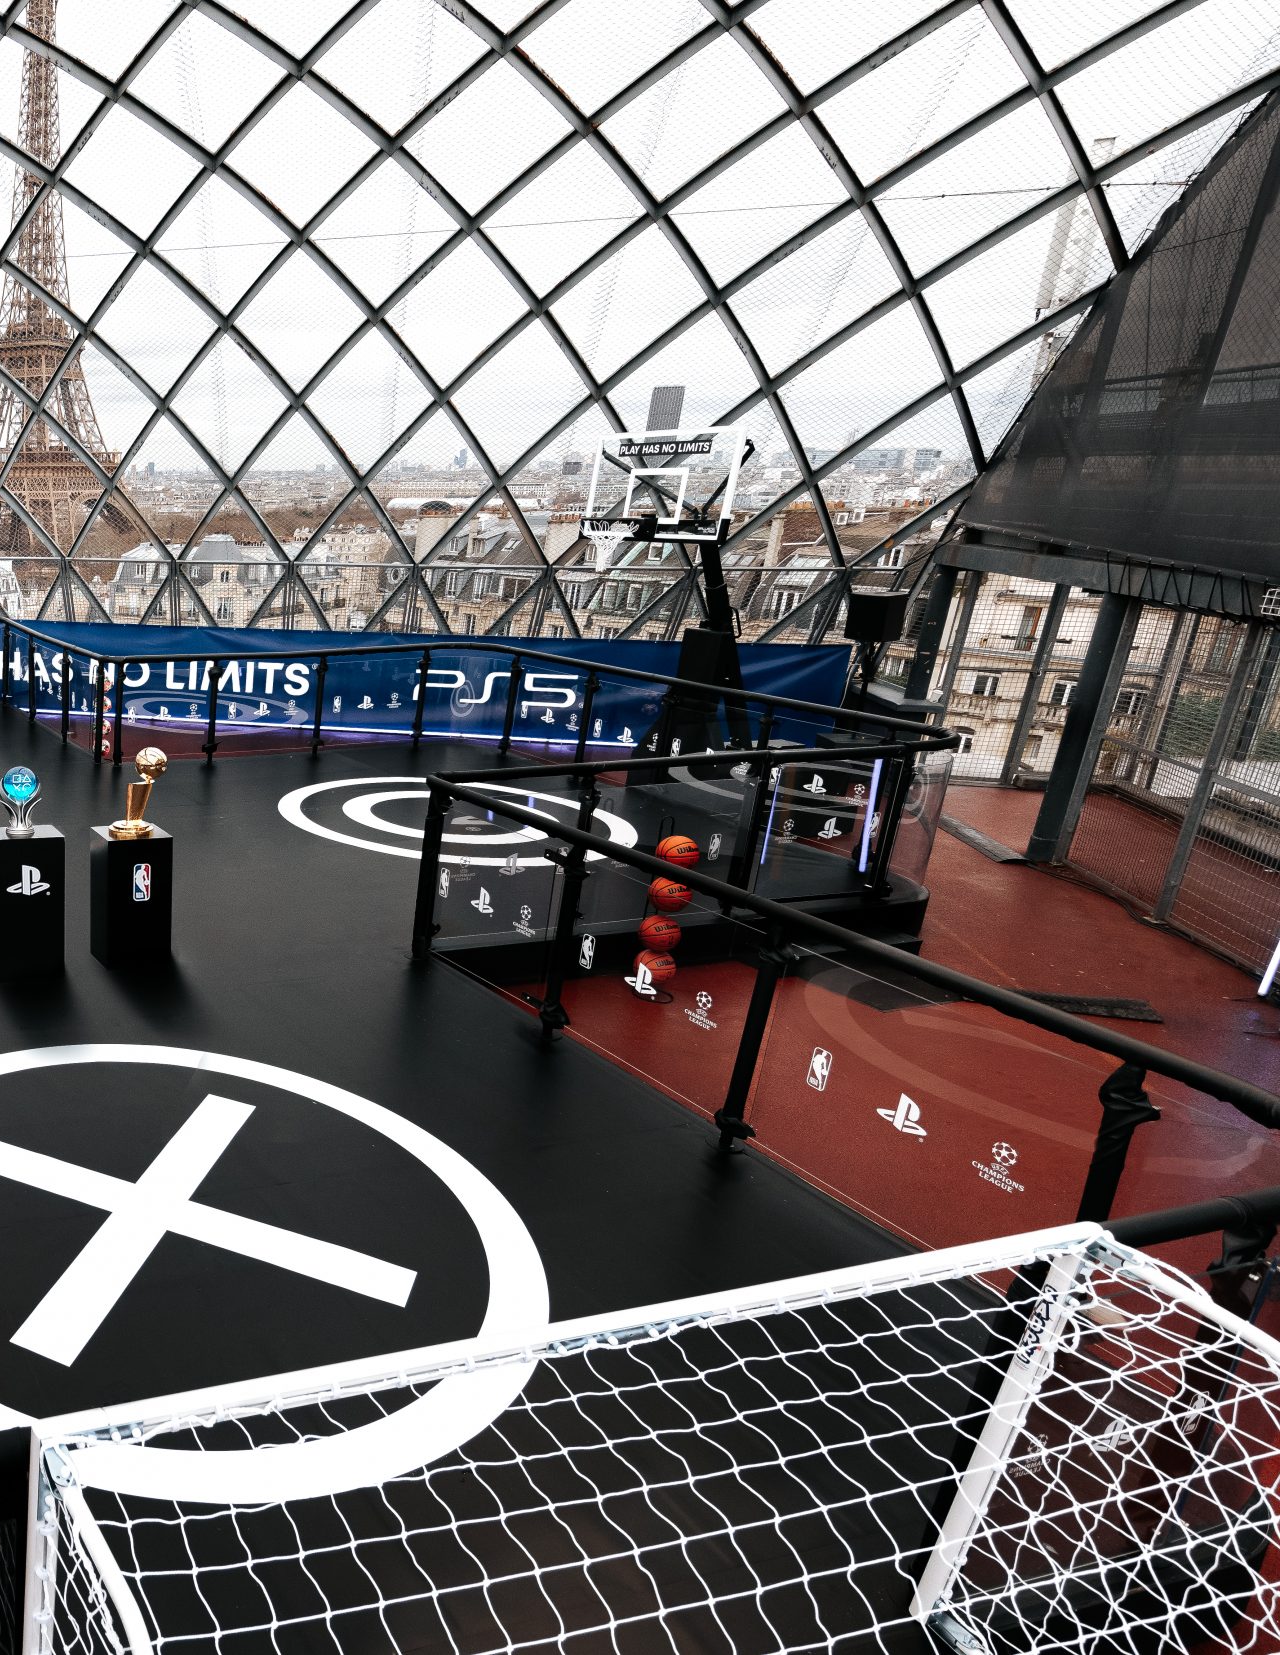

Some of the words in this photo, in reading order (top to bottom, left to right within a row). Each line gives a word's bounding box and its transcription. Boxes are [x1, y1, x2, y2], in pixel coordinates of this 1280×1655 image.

[620, 445, 640, 455] PLAY
[642, 444, 660, 454] HAS
[661, 443, 676, 453] NO
[678, 442, 709, 453] LIMITS
[88, 660, 150, 688] NO
[165, 660, 310, 696] LIMITS
[413, 668, 579, 708] PS5
[971, 1160, 1025, 1192] CHAMPIONS
[978, 1170, 1014, 1194] LEAGUE
